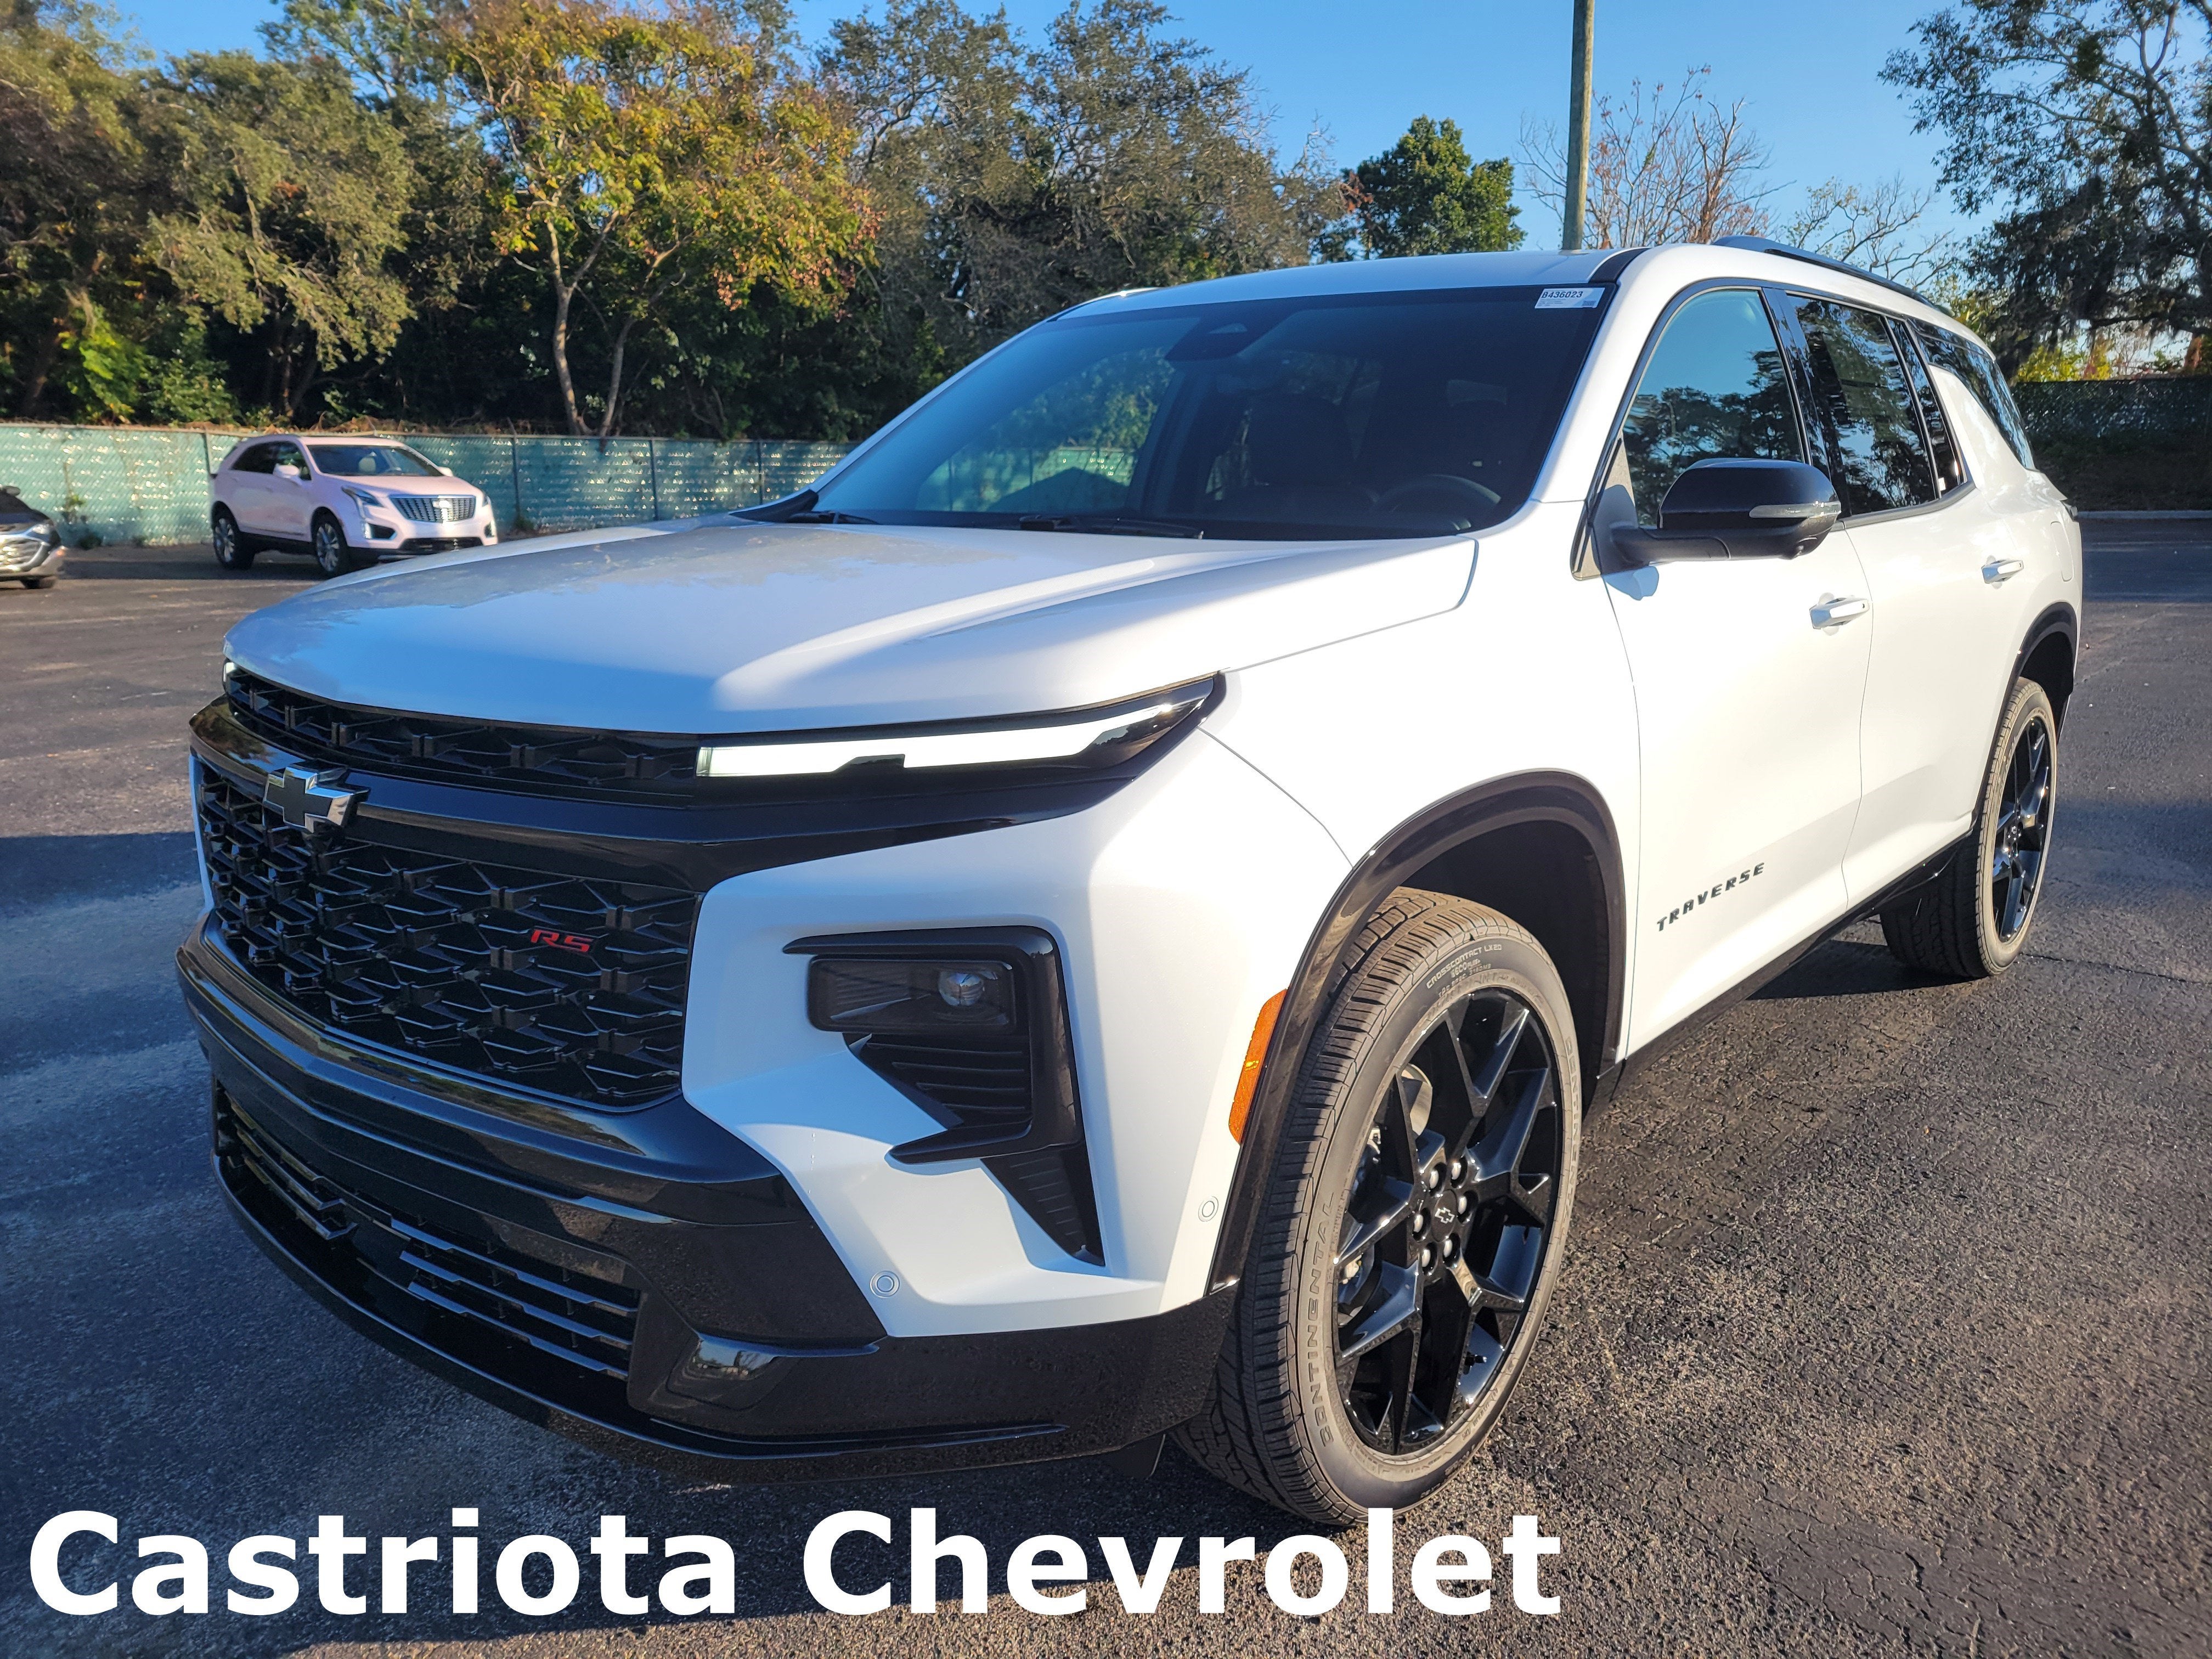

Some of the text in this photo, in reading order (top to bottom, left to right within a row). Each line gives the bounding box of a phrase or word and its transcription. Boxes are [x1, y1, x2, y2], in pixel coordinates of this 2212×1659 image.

[1656, 861, 1765, 932] TRAVERSE
[531, 929, 594, 952] RS
[1426, 946, 1482, 989] CROSSCONTACT
[1306, 1192, 1335, 1448] CONTINENTAL
